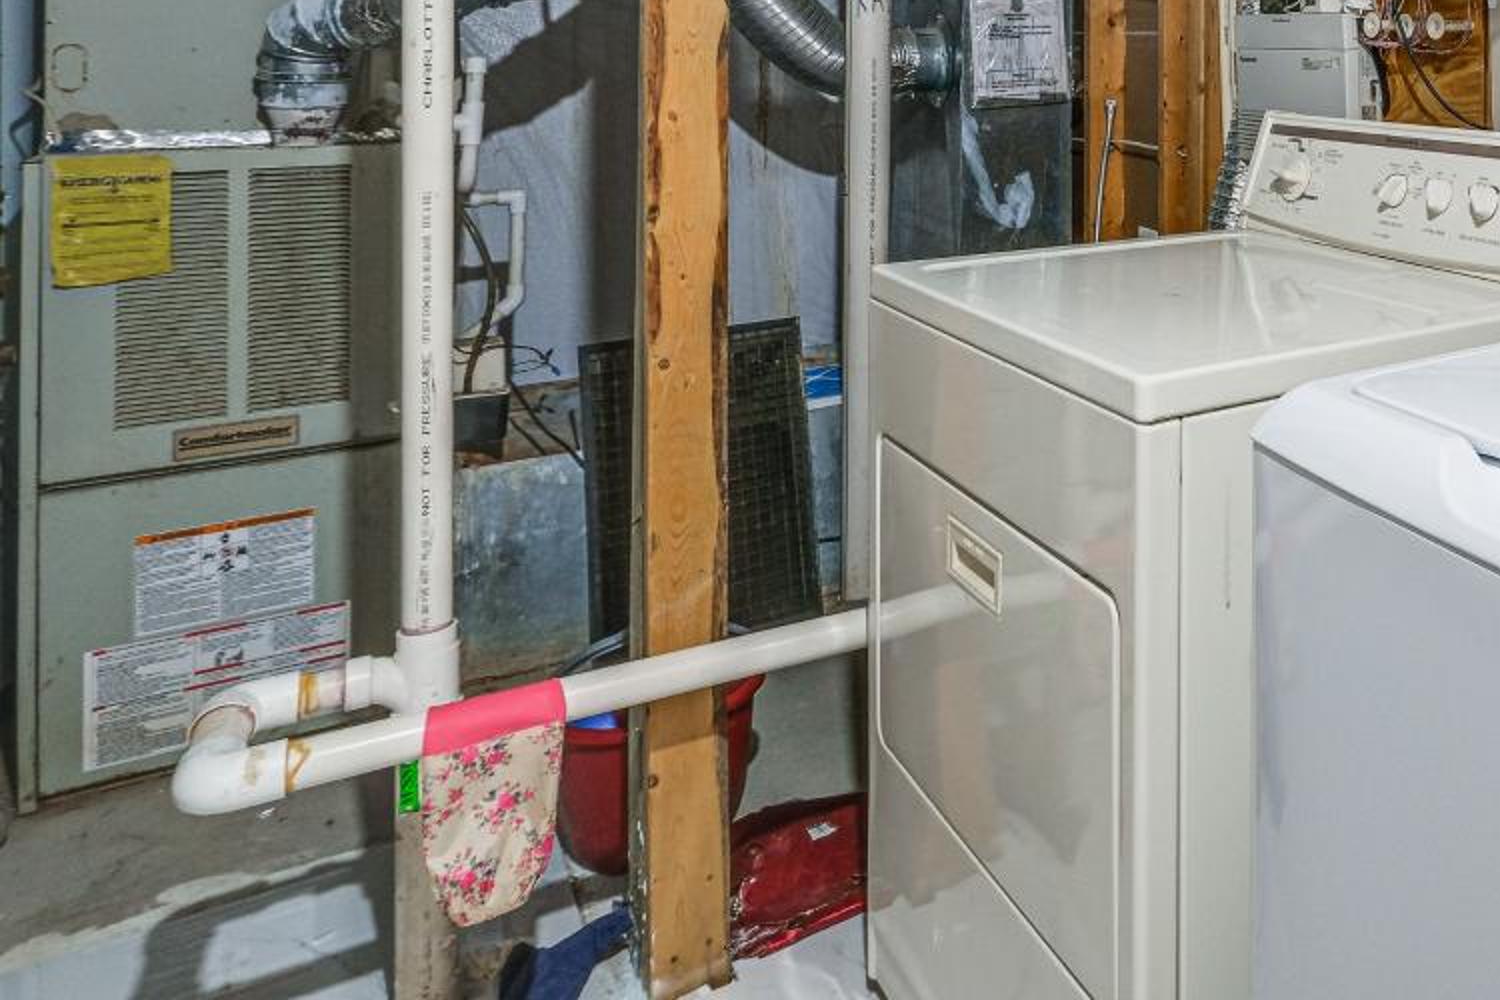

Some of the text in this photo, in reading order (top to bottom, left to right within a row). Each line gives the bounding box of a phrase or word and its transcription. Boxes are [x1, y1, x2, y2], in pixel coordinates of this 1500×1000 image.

[420, 352, 433, 436] PRESSURE
[421, 444, 433, 476] FOR
[421, 487, 433, 518] NOT
